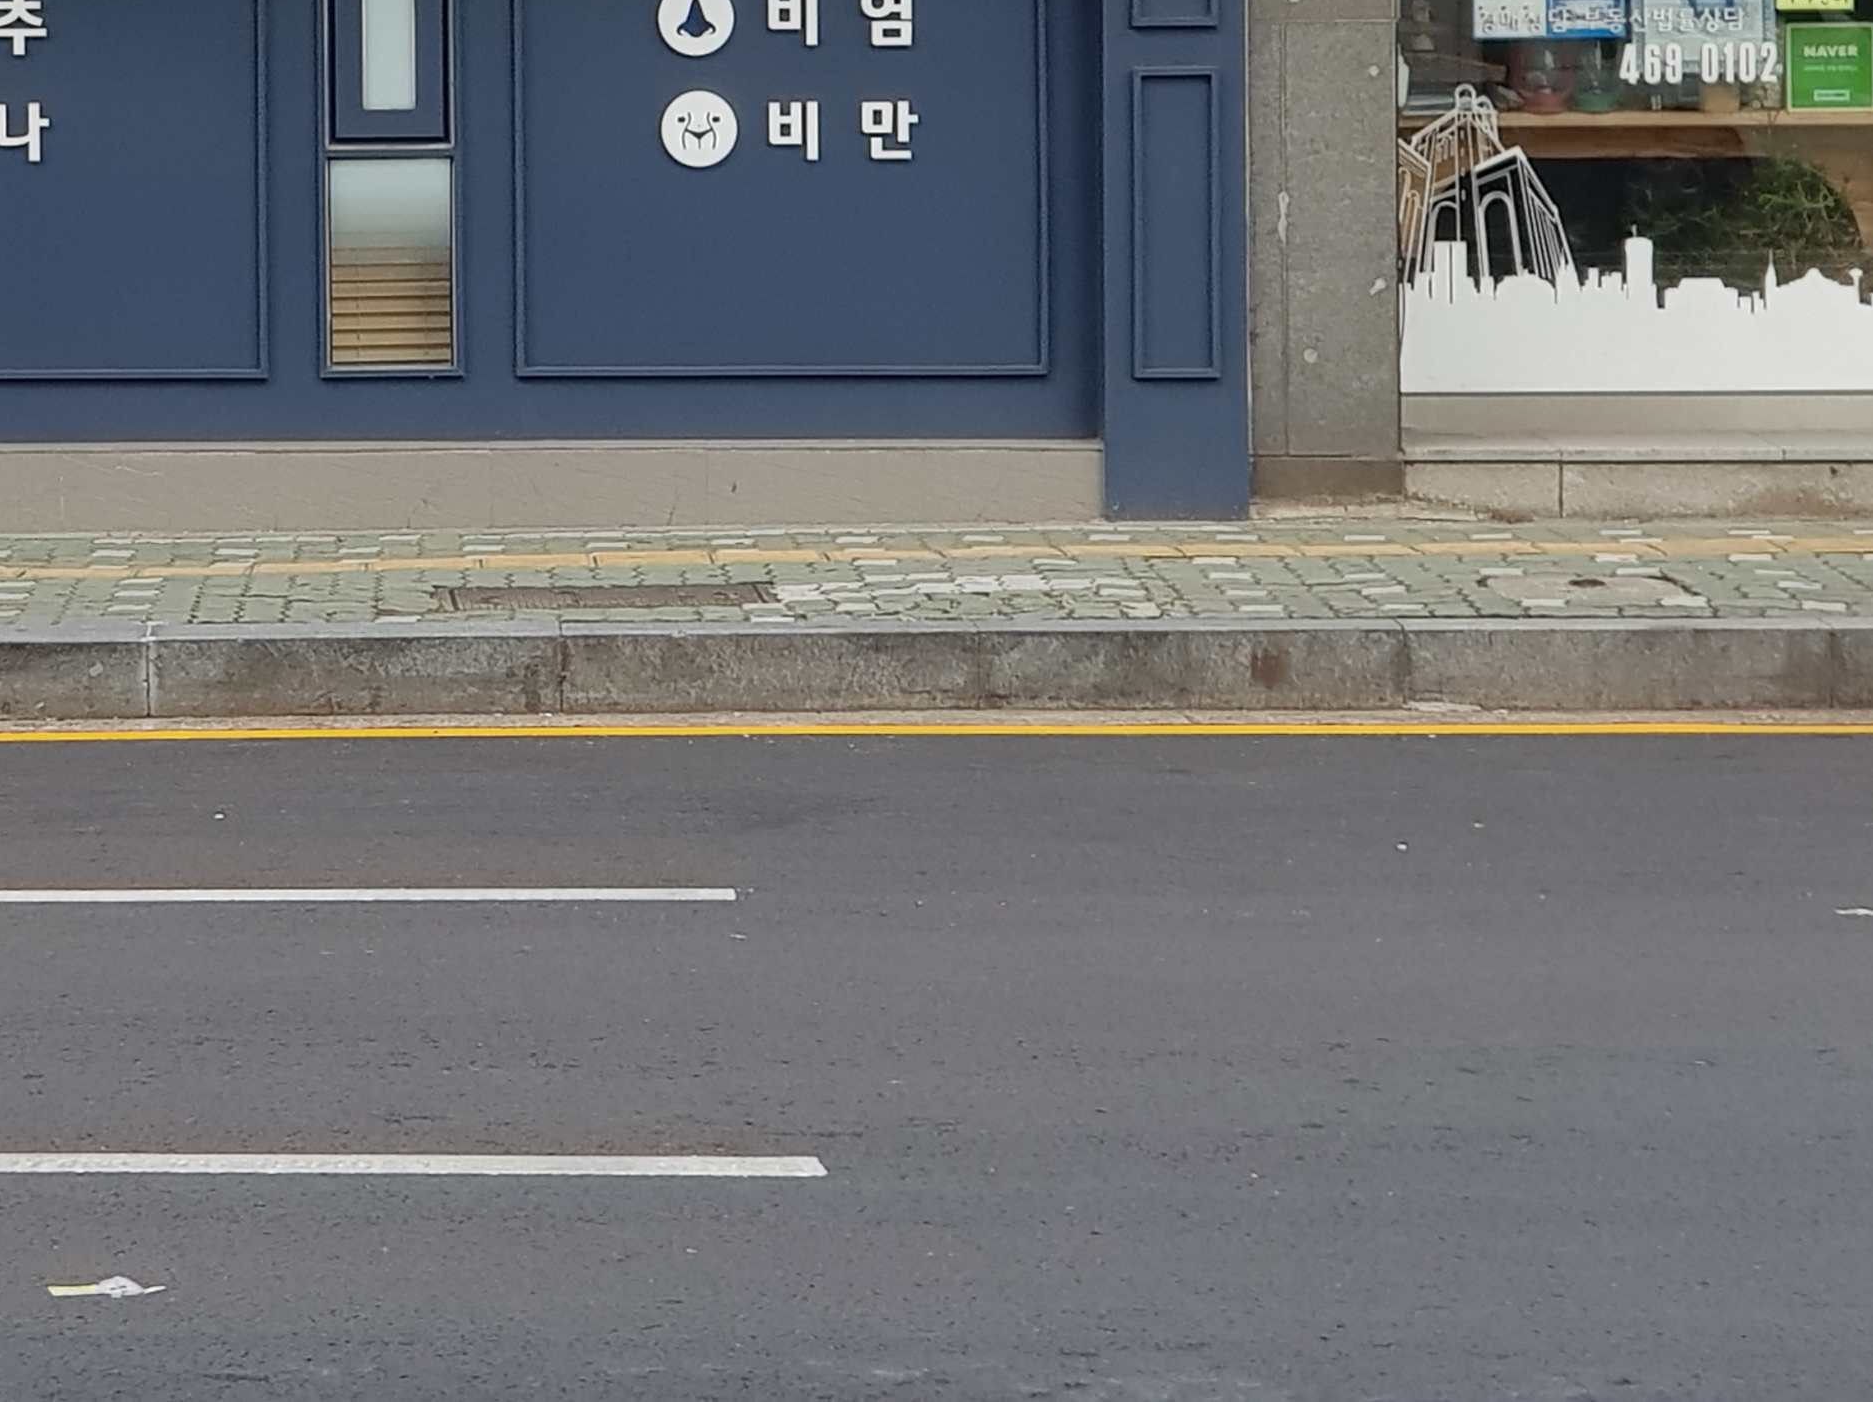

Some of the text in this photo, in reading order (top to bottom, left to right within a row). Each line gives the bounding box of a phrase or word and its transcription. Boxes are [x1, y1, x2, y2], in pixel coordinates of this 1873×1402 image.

[1619, 41, 1779, 85] 469 0102
[1803, 44, 1859, 57] NAVER
